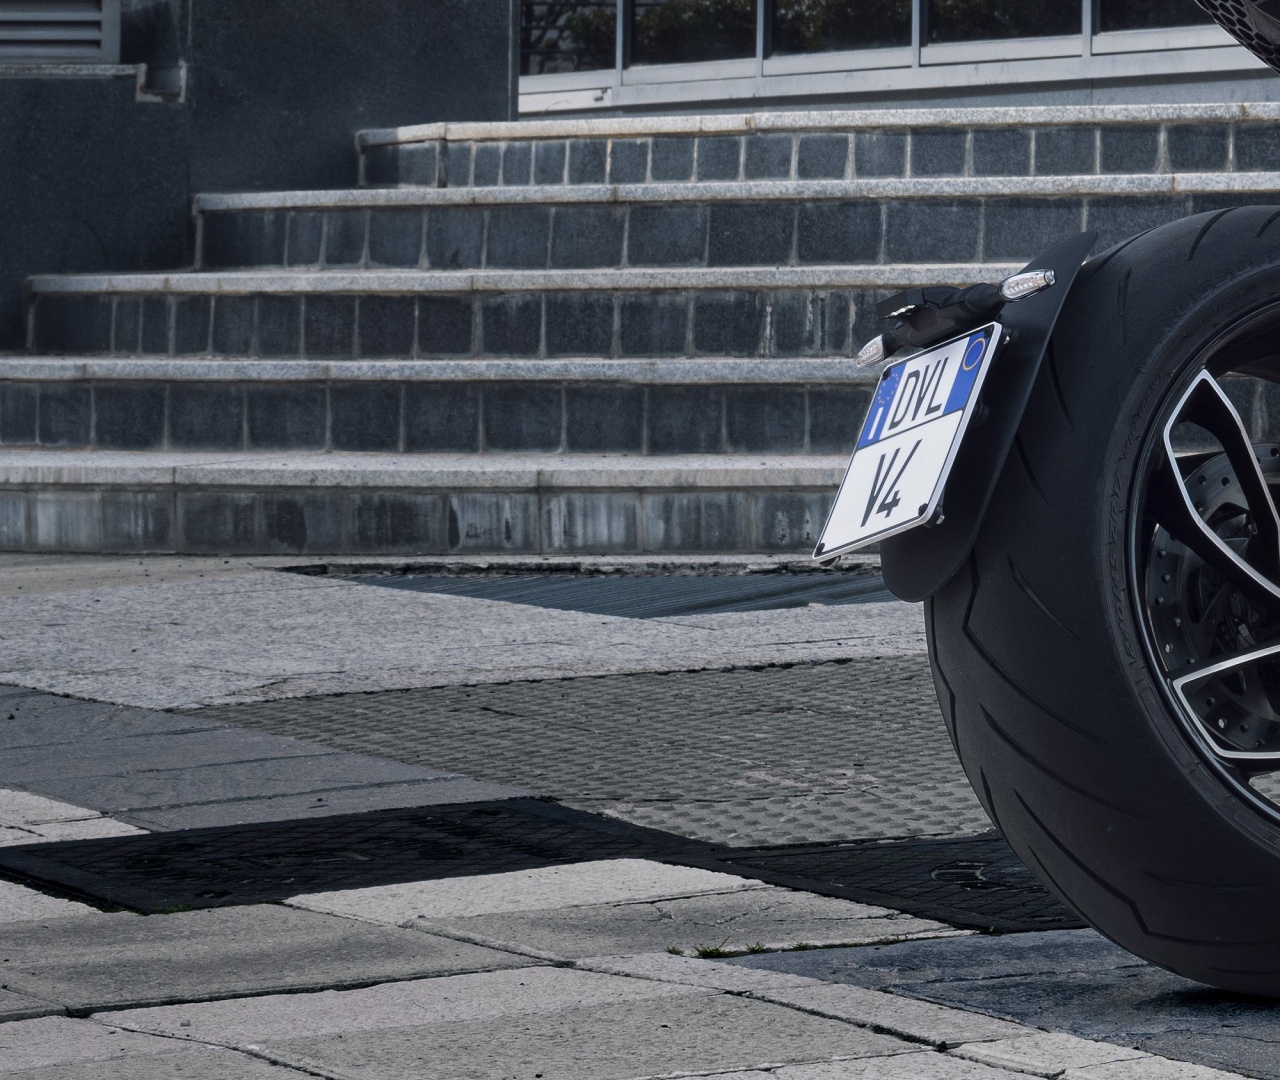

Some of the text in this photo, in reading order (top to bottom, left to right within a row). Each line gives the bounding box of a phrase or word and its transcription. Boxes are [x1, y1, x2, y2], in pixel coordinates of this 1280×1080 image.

[868, 407, 883, 440] I
[888, 356, 949, 431] DVL
[861, 439, 922, 527] V4
